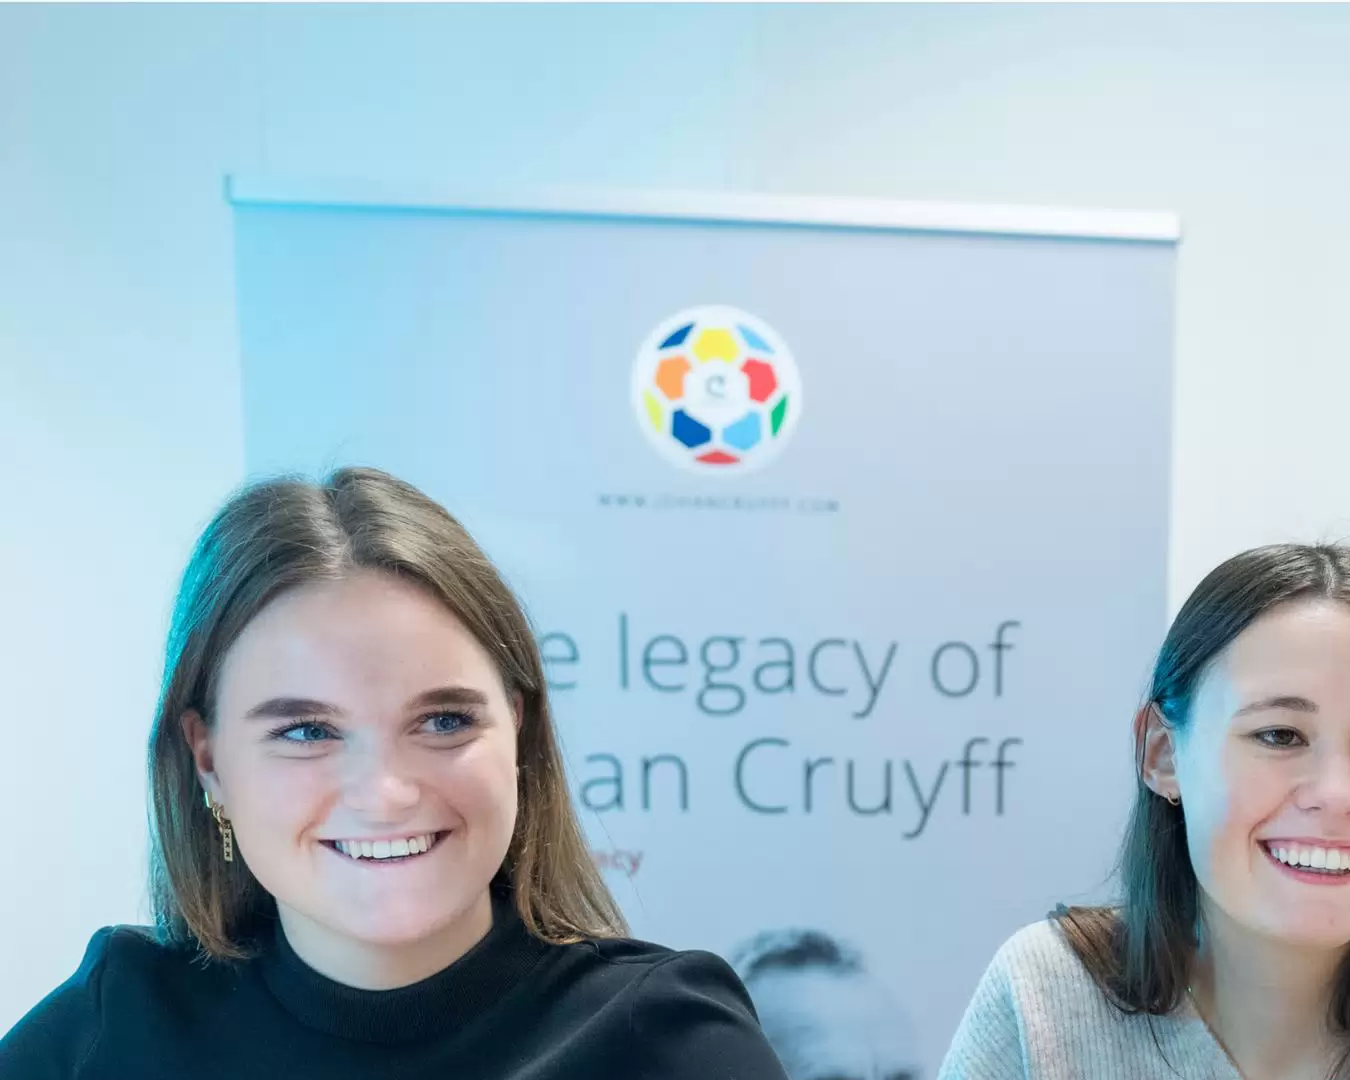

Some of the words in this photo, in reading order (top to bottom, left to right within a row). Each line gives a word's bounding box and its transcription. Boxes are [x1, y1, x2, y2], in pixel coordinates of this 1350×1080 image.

[618, 611, 899, 720] legacy
[928, 618, 1023, 699] of
[733, 735, 1025, 841] Cruyff
